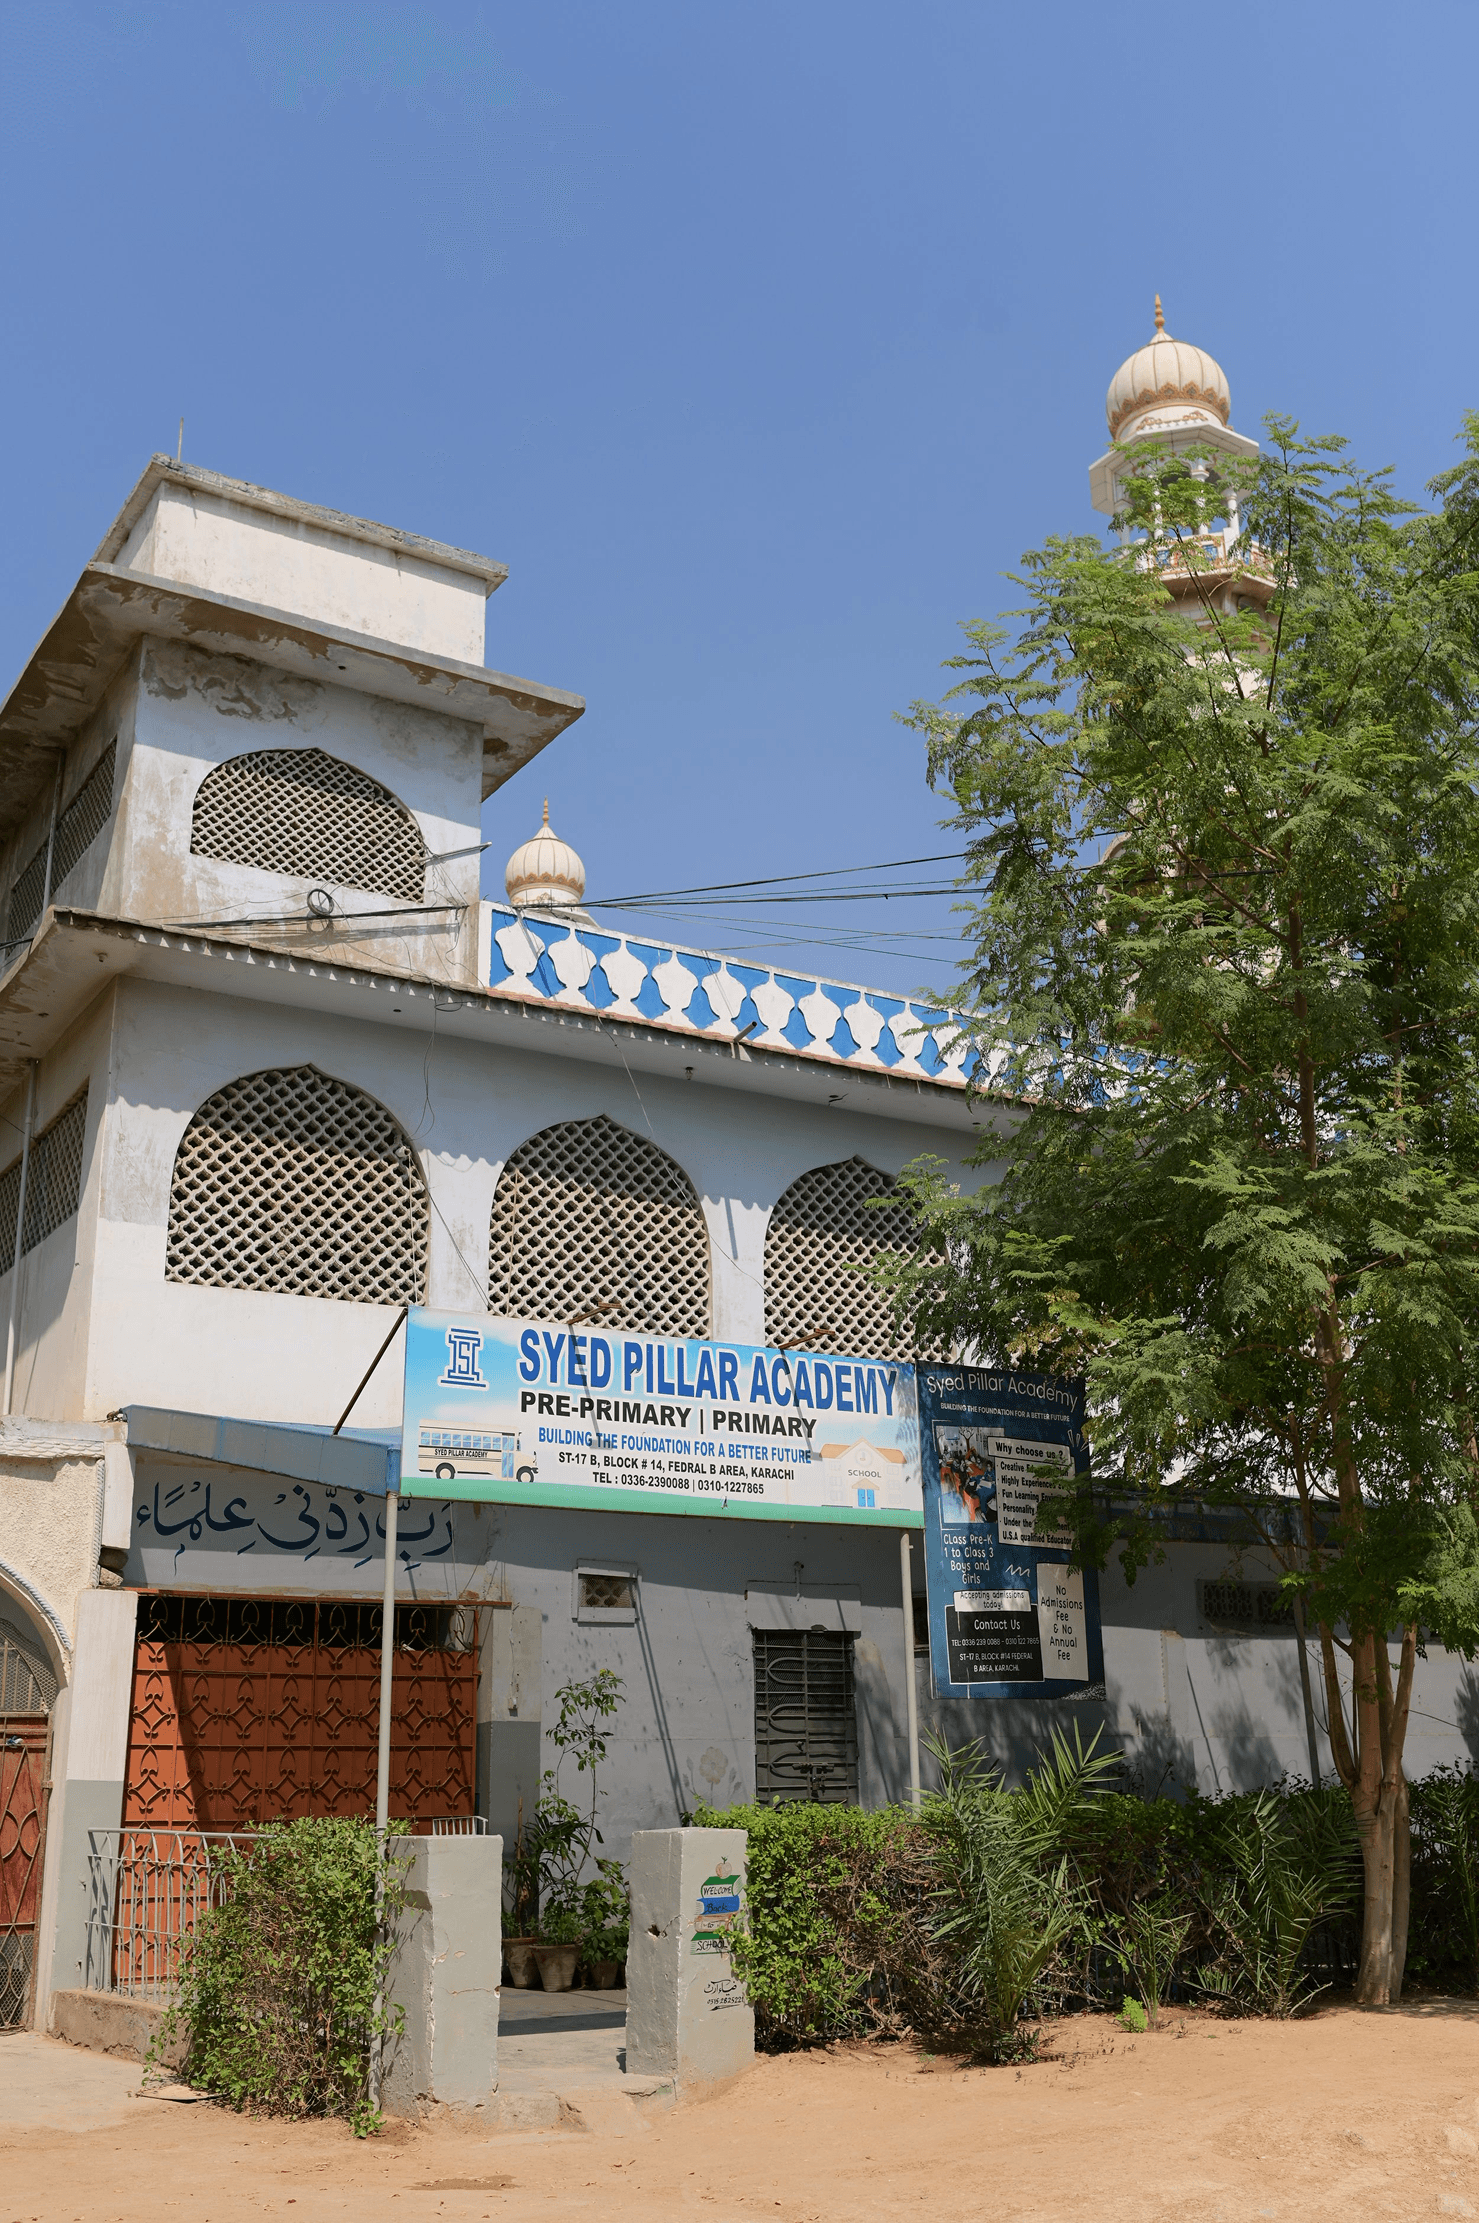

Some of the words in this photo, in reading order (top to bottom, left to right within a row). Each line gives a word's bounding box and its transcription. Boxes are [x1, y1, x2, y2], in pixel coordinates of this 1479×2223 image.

[519, 1329, 611, 1388] SYED
[624, 1341, 740, 1401] PILLAR
[750, 1355, 897, 1416] ACADEMY
[926, 1373, 965, 1398] Syed
[968, 1373, 1004, 1391] Pillar
[1008, 1377, 1078, 1413] Academy
[521, 1391, 691, 1428] PRE-PRIMARY
[713, 1410, 817, 1438] PRIMARY
[940, 1402, 966, 1411] BUILDING
[978, 1407, 1014, 1416] FOUNDATION
[1015, 1410, 1025, 1418] FOR
[1031, 1412, 1050, 1420] BETTER
[1051, 1414, 1070, 1422] FUTURE
[538, 1427, 593, 1446] BUILDING
[596, 1432, 618, 1449] THE
[621, 1434, 691, 1455] FOUNDATION
[694, 1441, 715, 1457] FOR
[718, 1443, 725, 1457] A
[728, 1443, 768, 1460] BETTER
[771, 1447, 812, 1464] FUTURE
[995, 1442, 1012, 1455] Why
[1015, 1445, 1044, 1458] choose
[1046, 1451, 1056, 1459] us
[558, 1451, 587, 1465] ST-17
[590, 1454, 601, 1469] B,
[603, 1455, 639, 1469] BLOCK
[641, 1459, 648, 1470] #
[651, 1459, 665, 1473] 14,
[668, 1461, 707, 1474] FEDRAL
[709, 1463, 716, 1475] B
[719, 1465, 749, 1479] AREA,
[751, 1467, 794, 1480] KARACHI
[1000, 1461, 1025, 1472] Creative
[847, 1469, 882, 1478] SCHOOL
[592, 1472, 612, 1484] TEL
[621, 1474, 690, 1489] 0336-2390088
[698, 1480, 764, 1494] 0310-1227865
[1001, 1475, 1019, 1487] Highly
[1002, 1489, 1013, 1498] Fun
[1014, 1490, 1040, 1502] Learning
[1002, 1503, 1035, 1516] Personality
[1003, 1517, 1020, 1527] Under
[1022, 1518, 1032, 1528] the
[970, 1534, 993, 1545] Pre-K
[1002, 1530, 1019, 1540] U.S.A
[1020, 1532, 1045, 1544] qualified
[944, 1547, 948, 1558] 1
[951, 1547, 961, 1558] to
[964, 1547, 986, 1558] Class
[989, 1547, 994, 1558] 3
[950, 1560, 971, 1573] Boys
[974, 1560, 990, 1571] and
[962, 1573, 981, 1584] Girls
[960, 1591, 990, 1600] Accepting
[992, 1591, 1024, 1599] admissions
[1055, 1585, 1067, 1596] No
[983, 1600, 1003, 1609] today!
[1041, 1597, 1083, 1610] Admissions
[1056, 1612, 1069, 1622] Fee
[974, 1619, 1008, 1630] Contact
[1010, 1619, 1021, 1630] Us
[1053, 1624, 1059, 1634] &
[1062, 1624, 1072, 1635] No
[1049, 1636, 1077, 1648] Annual
[1057, 1650, 1071, 1661] Fee
[703, 1886, 732, 1896] WELCOME
[705, 1902, 728, 1913] Back
[696, 1940, 728, 1952] SCHOOL
